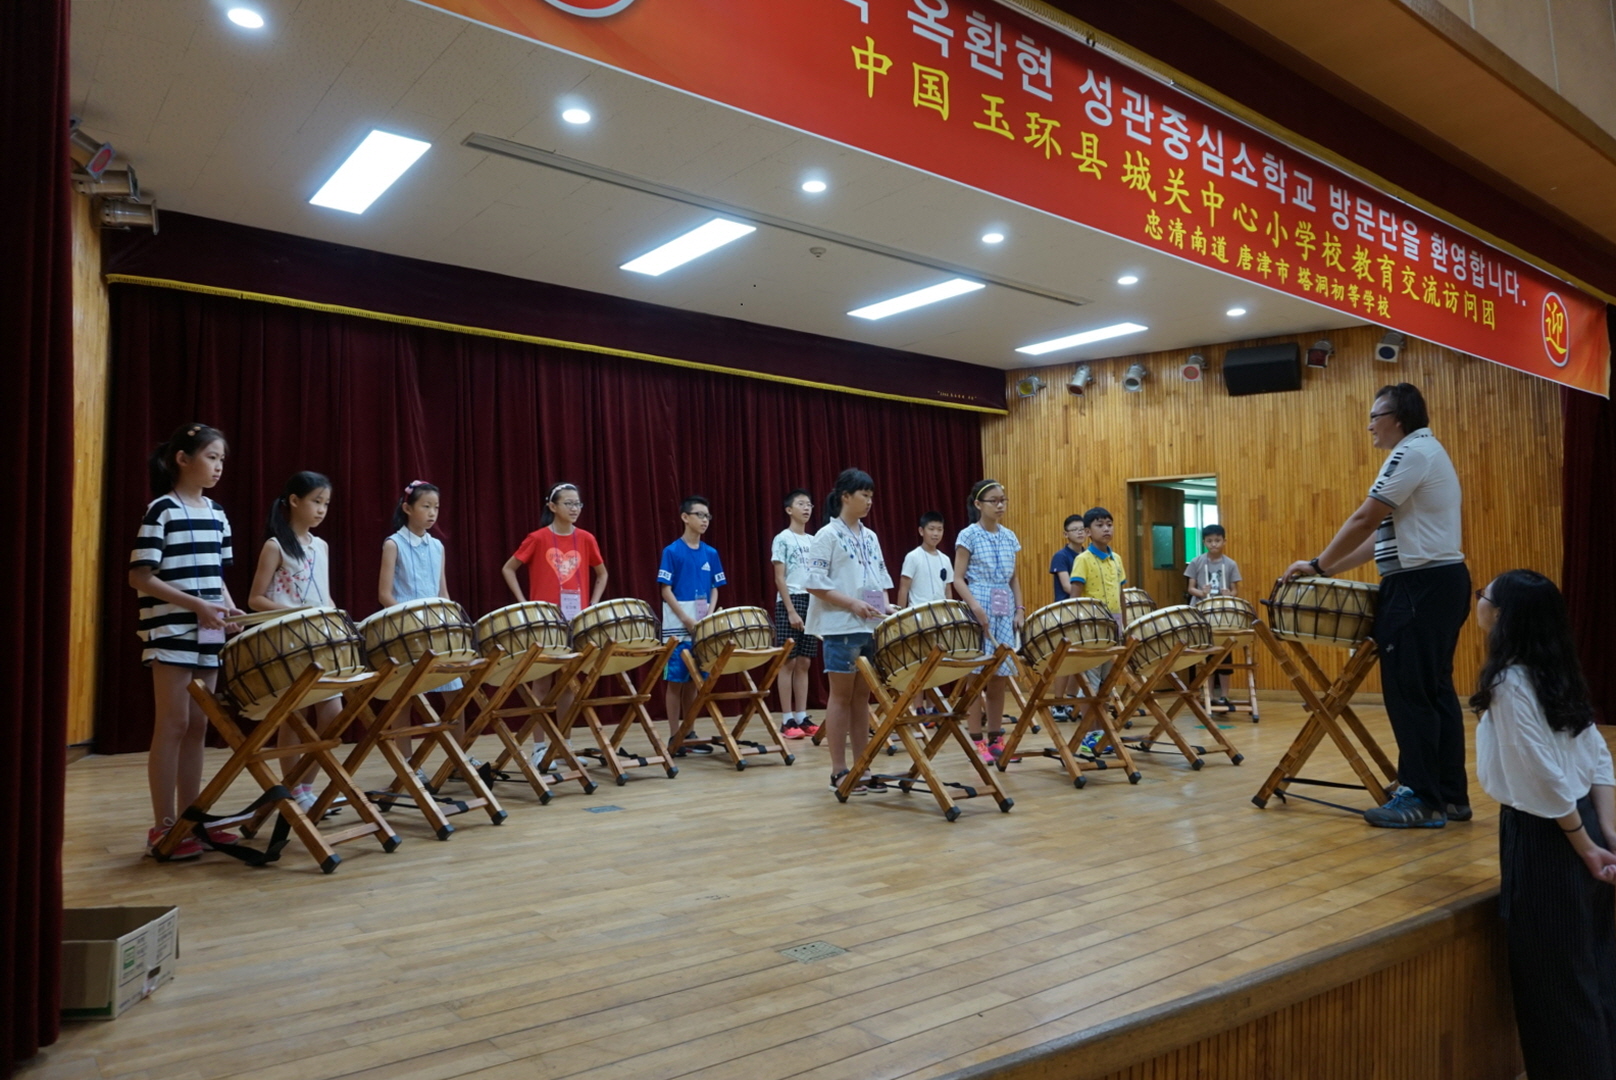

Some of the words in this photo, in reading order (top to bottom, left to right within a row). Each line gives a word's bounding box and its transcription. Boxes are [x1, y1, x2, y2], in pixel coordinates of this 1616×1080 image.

[907, 0, 1053, 102] 옥환현
[1078, 68, 1316, 212] 성관중심소학교
[1330, 184, 1420, 263] 방문단을
[1430, 232, 1527, 306] 환영합니다.
[1544, 301, 1567, 356] 迎
